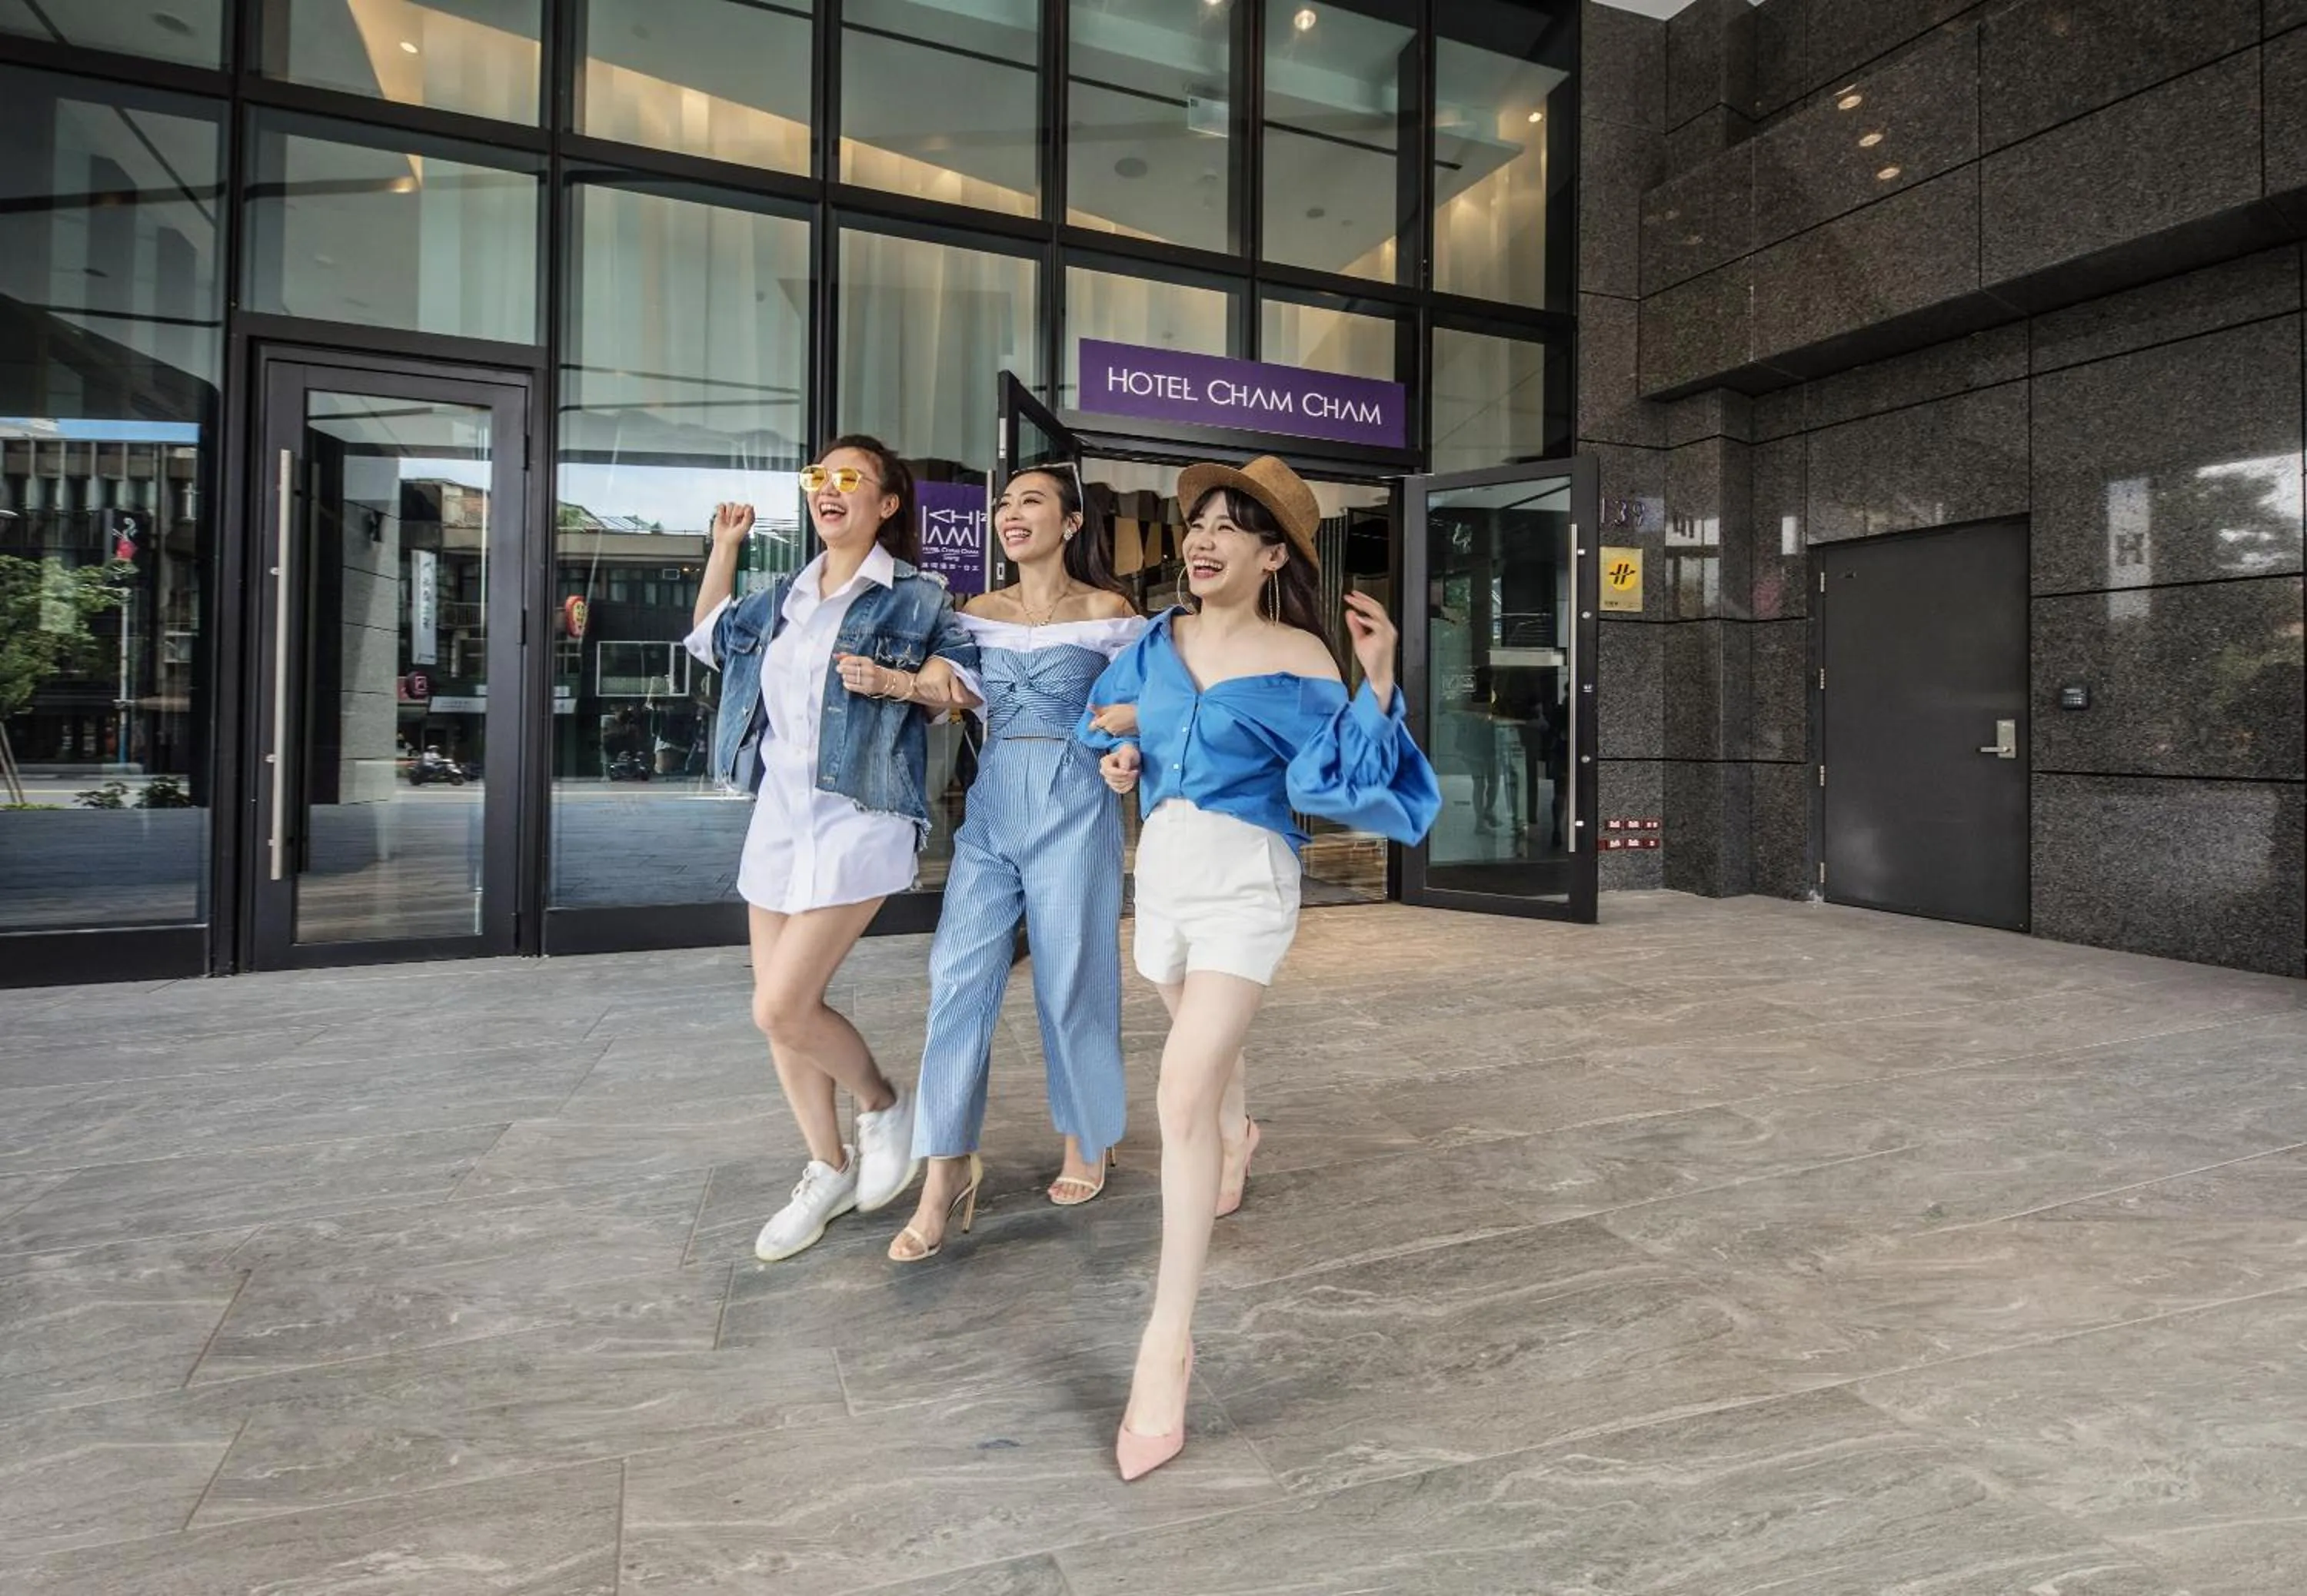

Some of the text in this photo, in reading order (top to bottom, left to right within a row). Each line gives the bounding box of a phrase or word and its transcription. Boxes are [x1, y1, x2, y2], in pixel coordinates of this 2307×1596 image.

[1107, 366, 1382, 426] HOTEL CHAM CHAM
